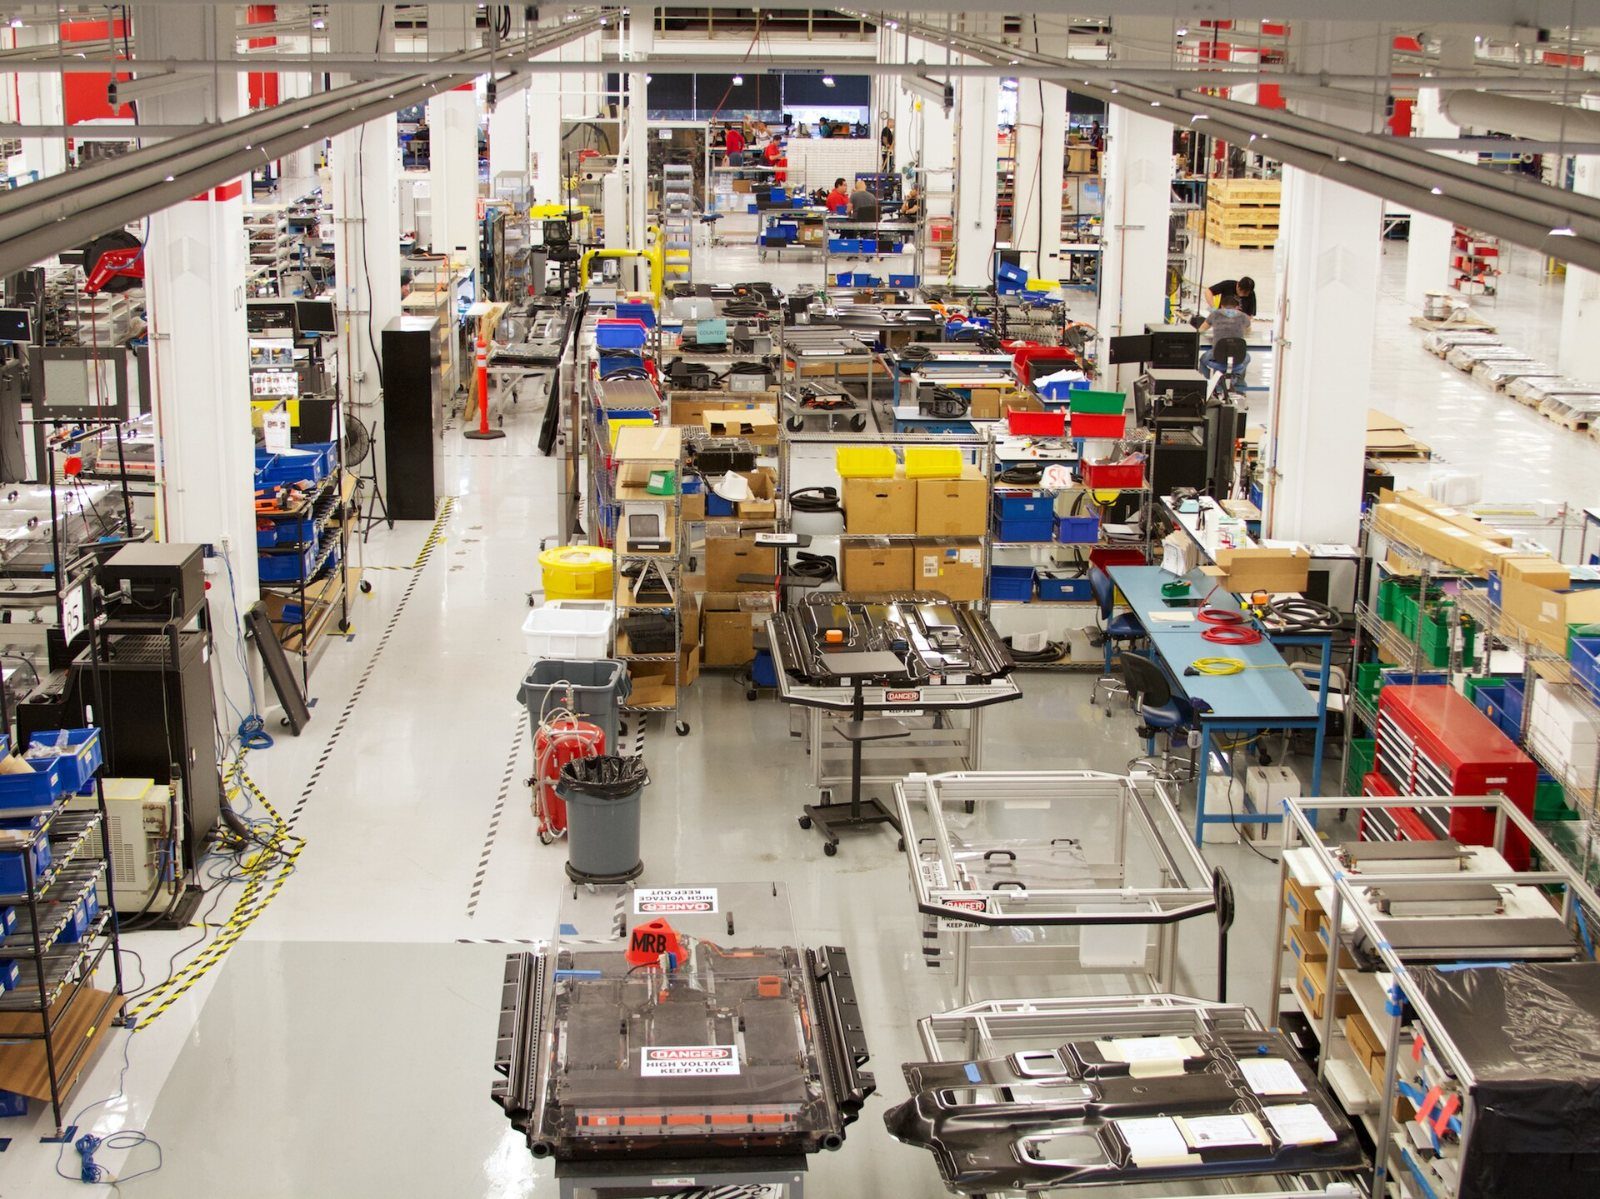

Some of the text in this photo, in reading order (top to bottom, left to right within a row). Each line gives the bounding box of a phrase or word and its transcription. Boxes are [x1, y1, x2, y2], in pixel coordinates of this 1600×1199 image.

[889, 692, 917, 700] DANGER
[650, 903, 704, 911] DANGER
[632, 932, 667, 953] MRB
[656, 1049, 723, 1059] DANGER
